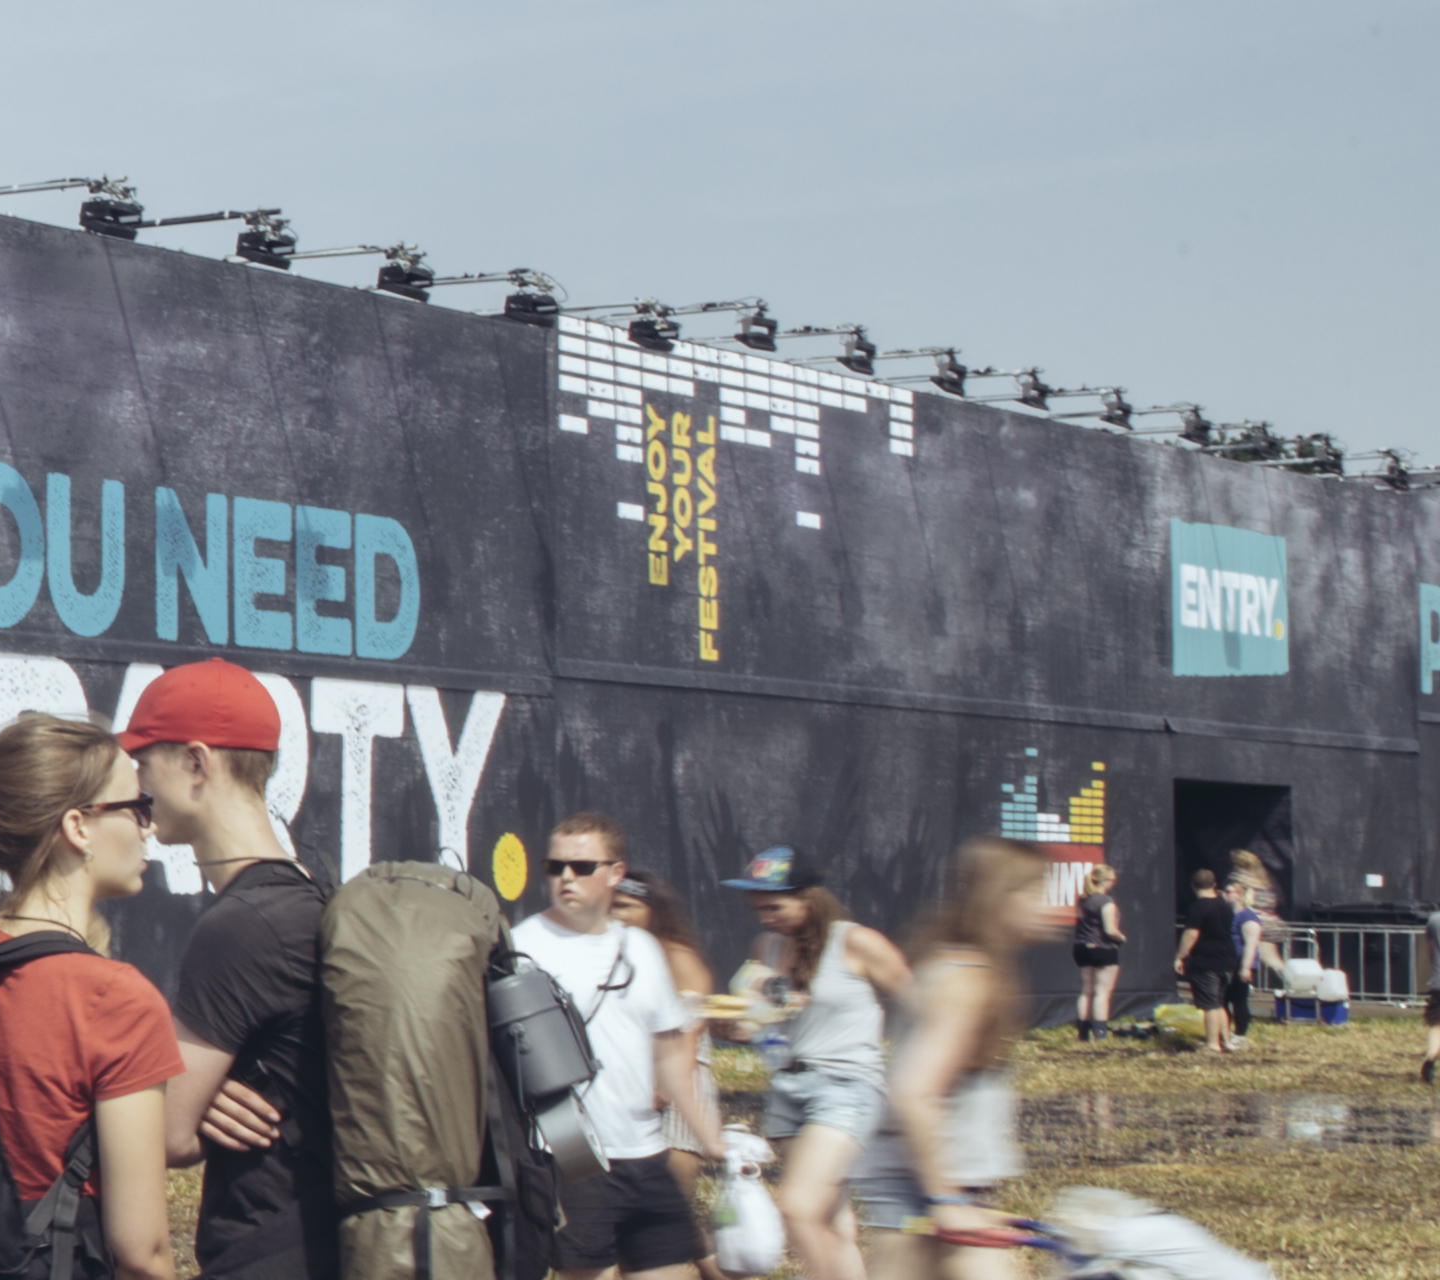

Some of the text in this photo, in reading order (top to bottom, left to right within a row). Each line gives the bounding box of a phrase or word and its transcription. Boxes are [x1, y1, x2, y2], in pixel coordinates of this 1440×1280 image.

[154, 484, 421, 661] NEED
[646, 402, 669, 586] ENJOY
[672, 411, 693, 562] YOUR
[697, 415, 719, 661] FESTIVAL
[1179, 563, 1285, 641] ENTRY.
